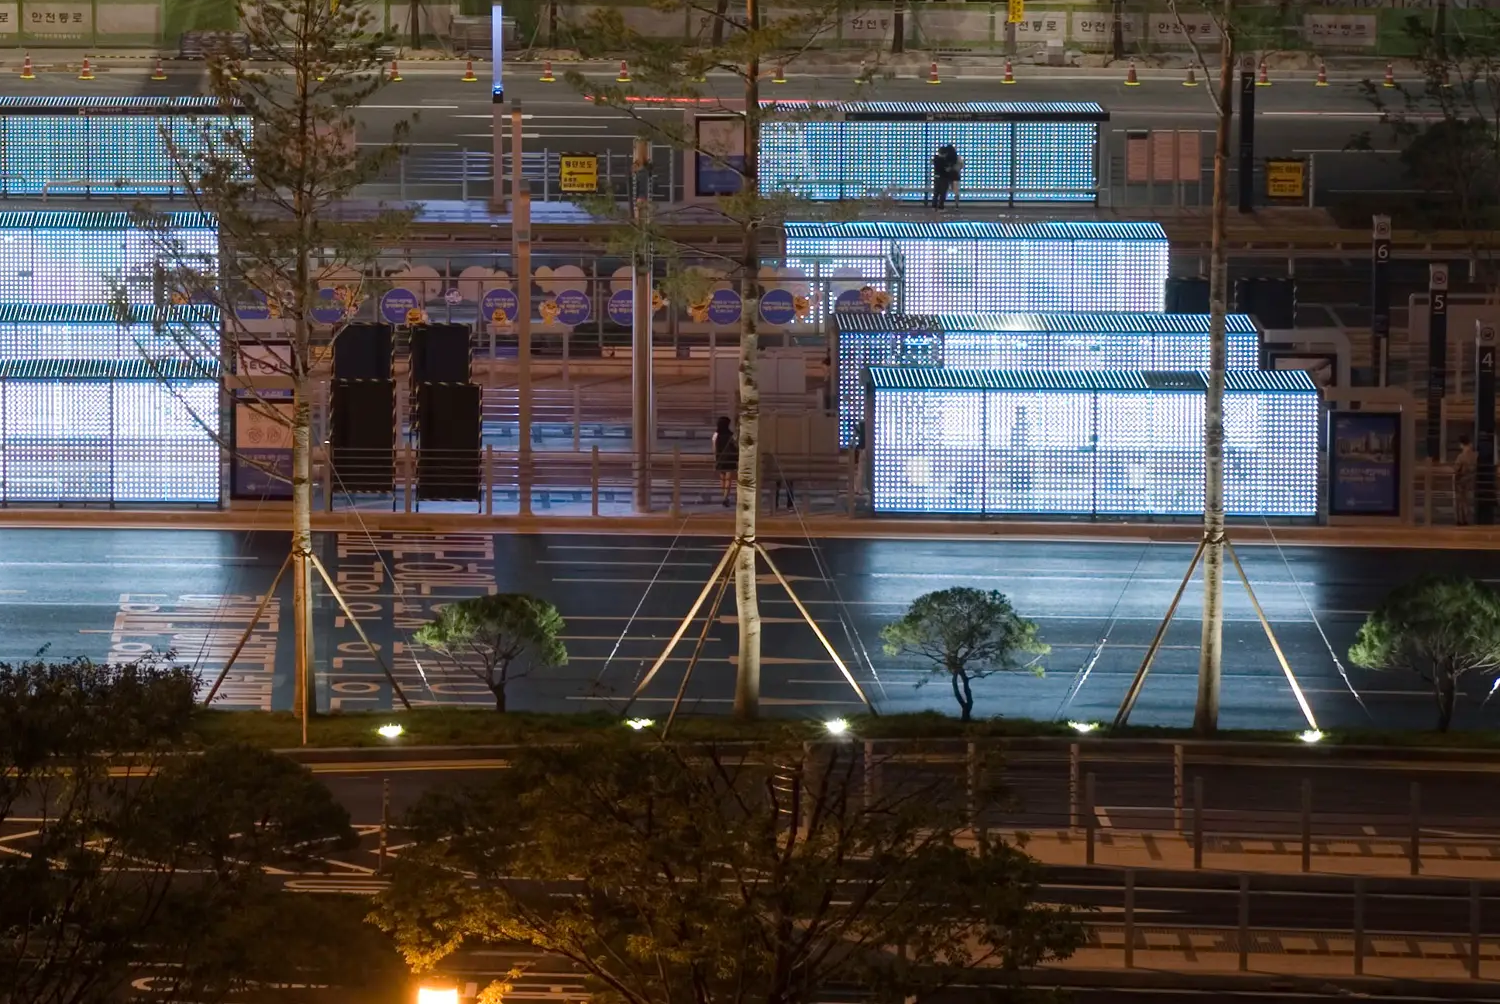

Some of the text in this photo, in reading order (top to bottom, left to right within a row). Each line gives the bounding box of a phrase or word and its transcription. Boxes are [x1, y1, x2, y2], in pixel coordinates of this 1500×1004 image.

[31, 11, 83, 24] 안전통로
[1243, 76, 1254, 90] 7
[1378, 244, 1389, 259] 6
[1433, 294, 1444, 310] 5
[1481, 352, 1494, 367] 4
